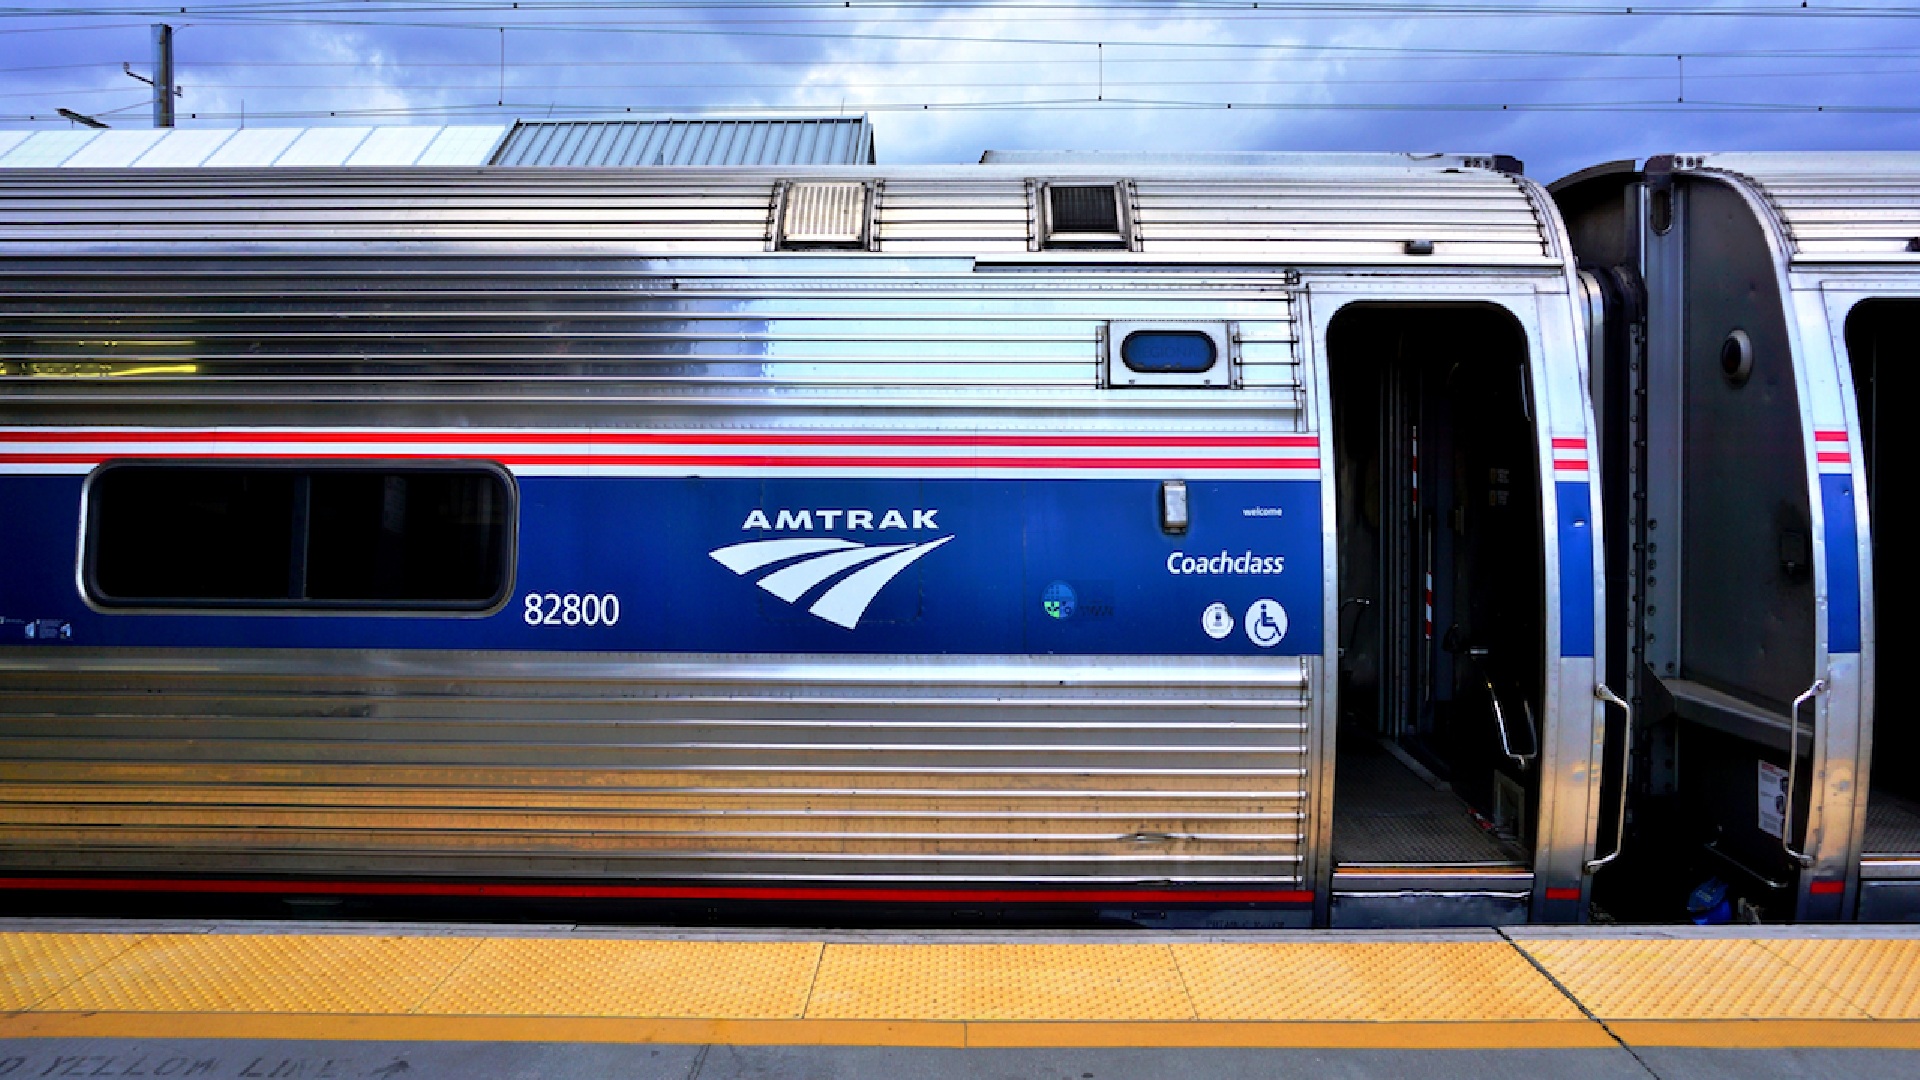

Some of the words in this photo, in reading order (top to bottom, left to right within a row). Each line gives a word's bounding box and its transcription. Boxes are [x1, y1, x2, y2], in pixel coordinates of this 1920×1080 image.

[742, 509, 940, 530] AMTRAK
[1242, 506, 1283, 516] welcome
[1167, 549, 1285, 575] Coachclass
[524, 593, 620, 626] 82800
[40, 1055, 220, 1077] YELLOW
